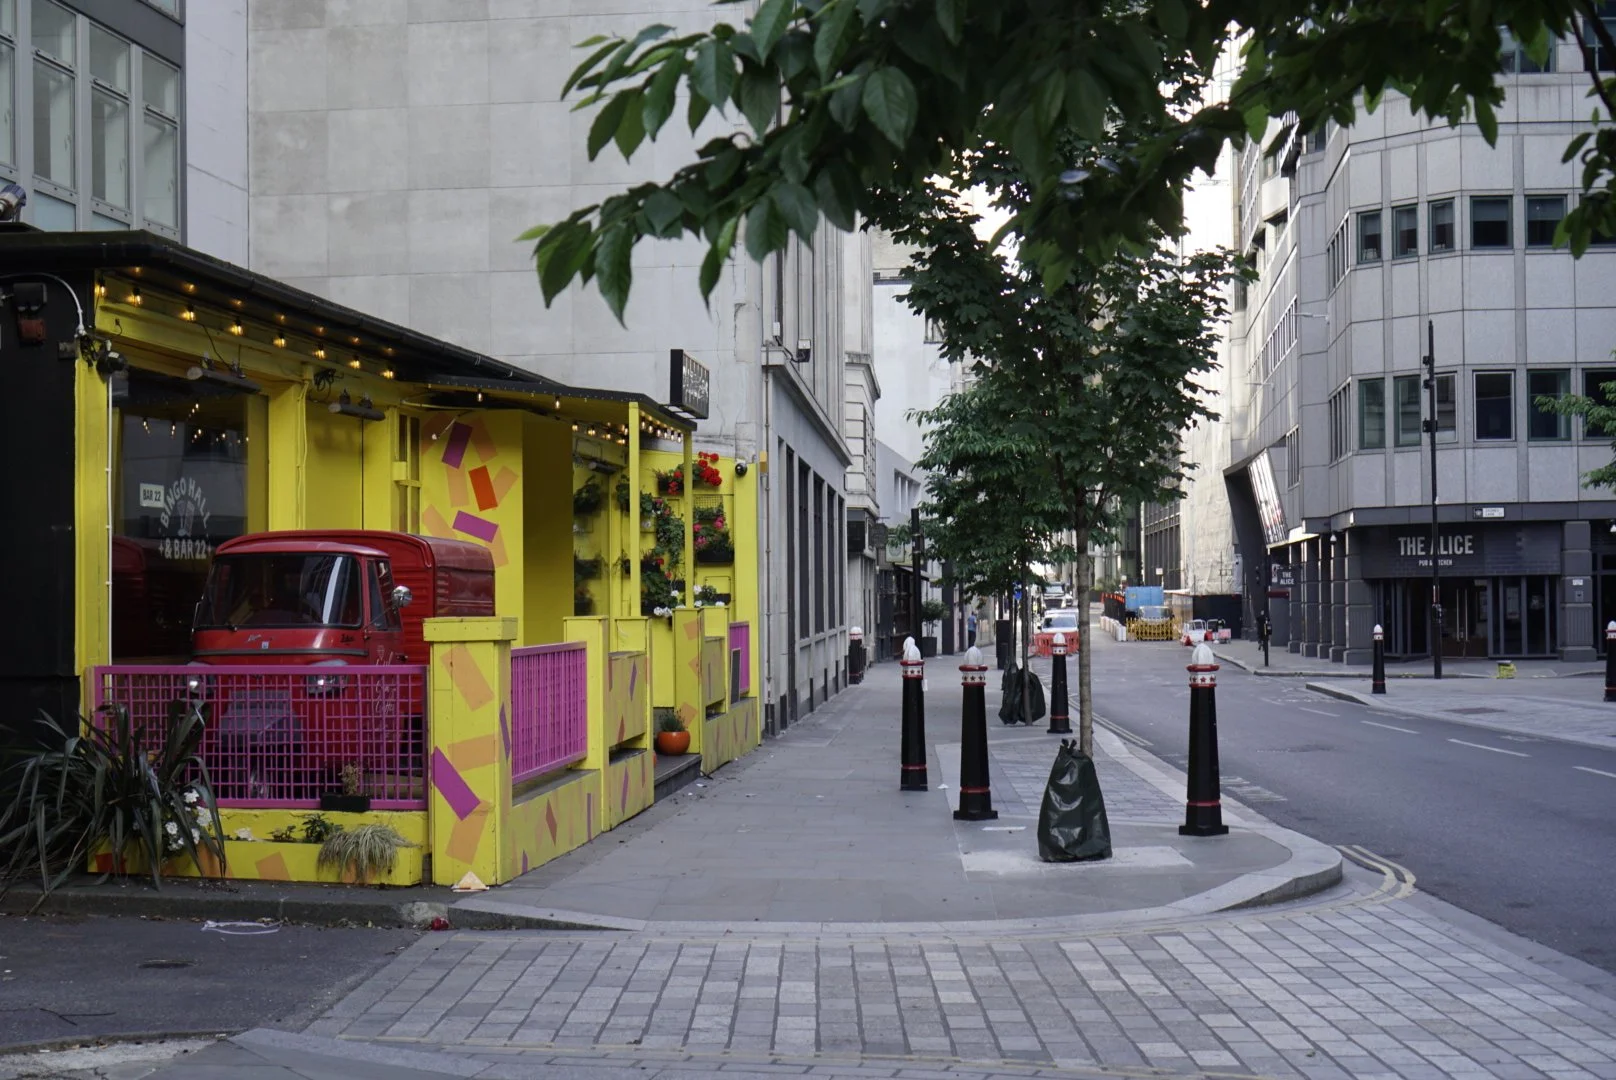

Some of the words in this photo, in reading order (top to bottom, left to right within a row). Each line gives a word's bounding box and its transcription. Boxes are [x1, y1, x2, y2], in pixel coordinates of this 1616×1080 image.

[143, 488, 153, 501] BAR
[154, 490, 161, 502] 22
[161, 477, 187, 528] BINGO
[188, 477, 210, 528] HALL
[164, 537, 172, 560] &
[174, 538, 194, 560] BAR
[195, 539, 207, 560] 22
[1398, 536, 1426, 556] THE
